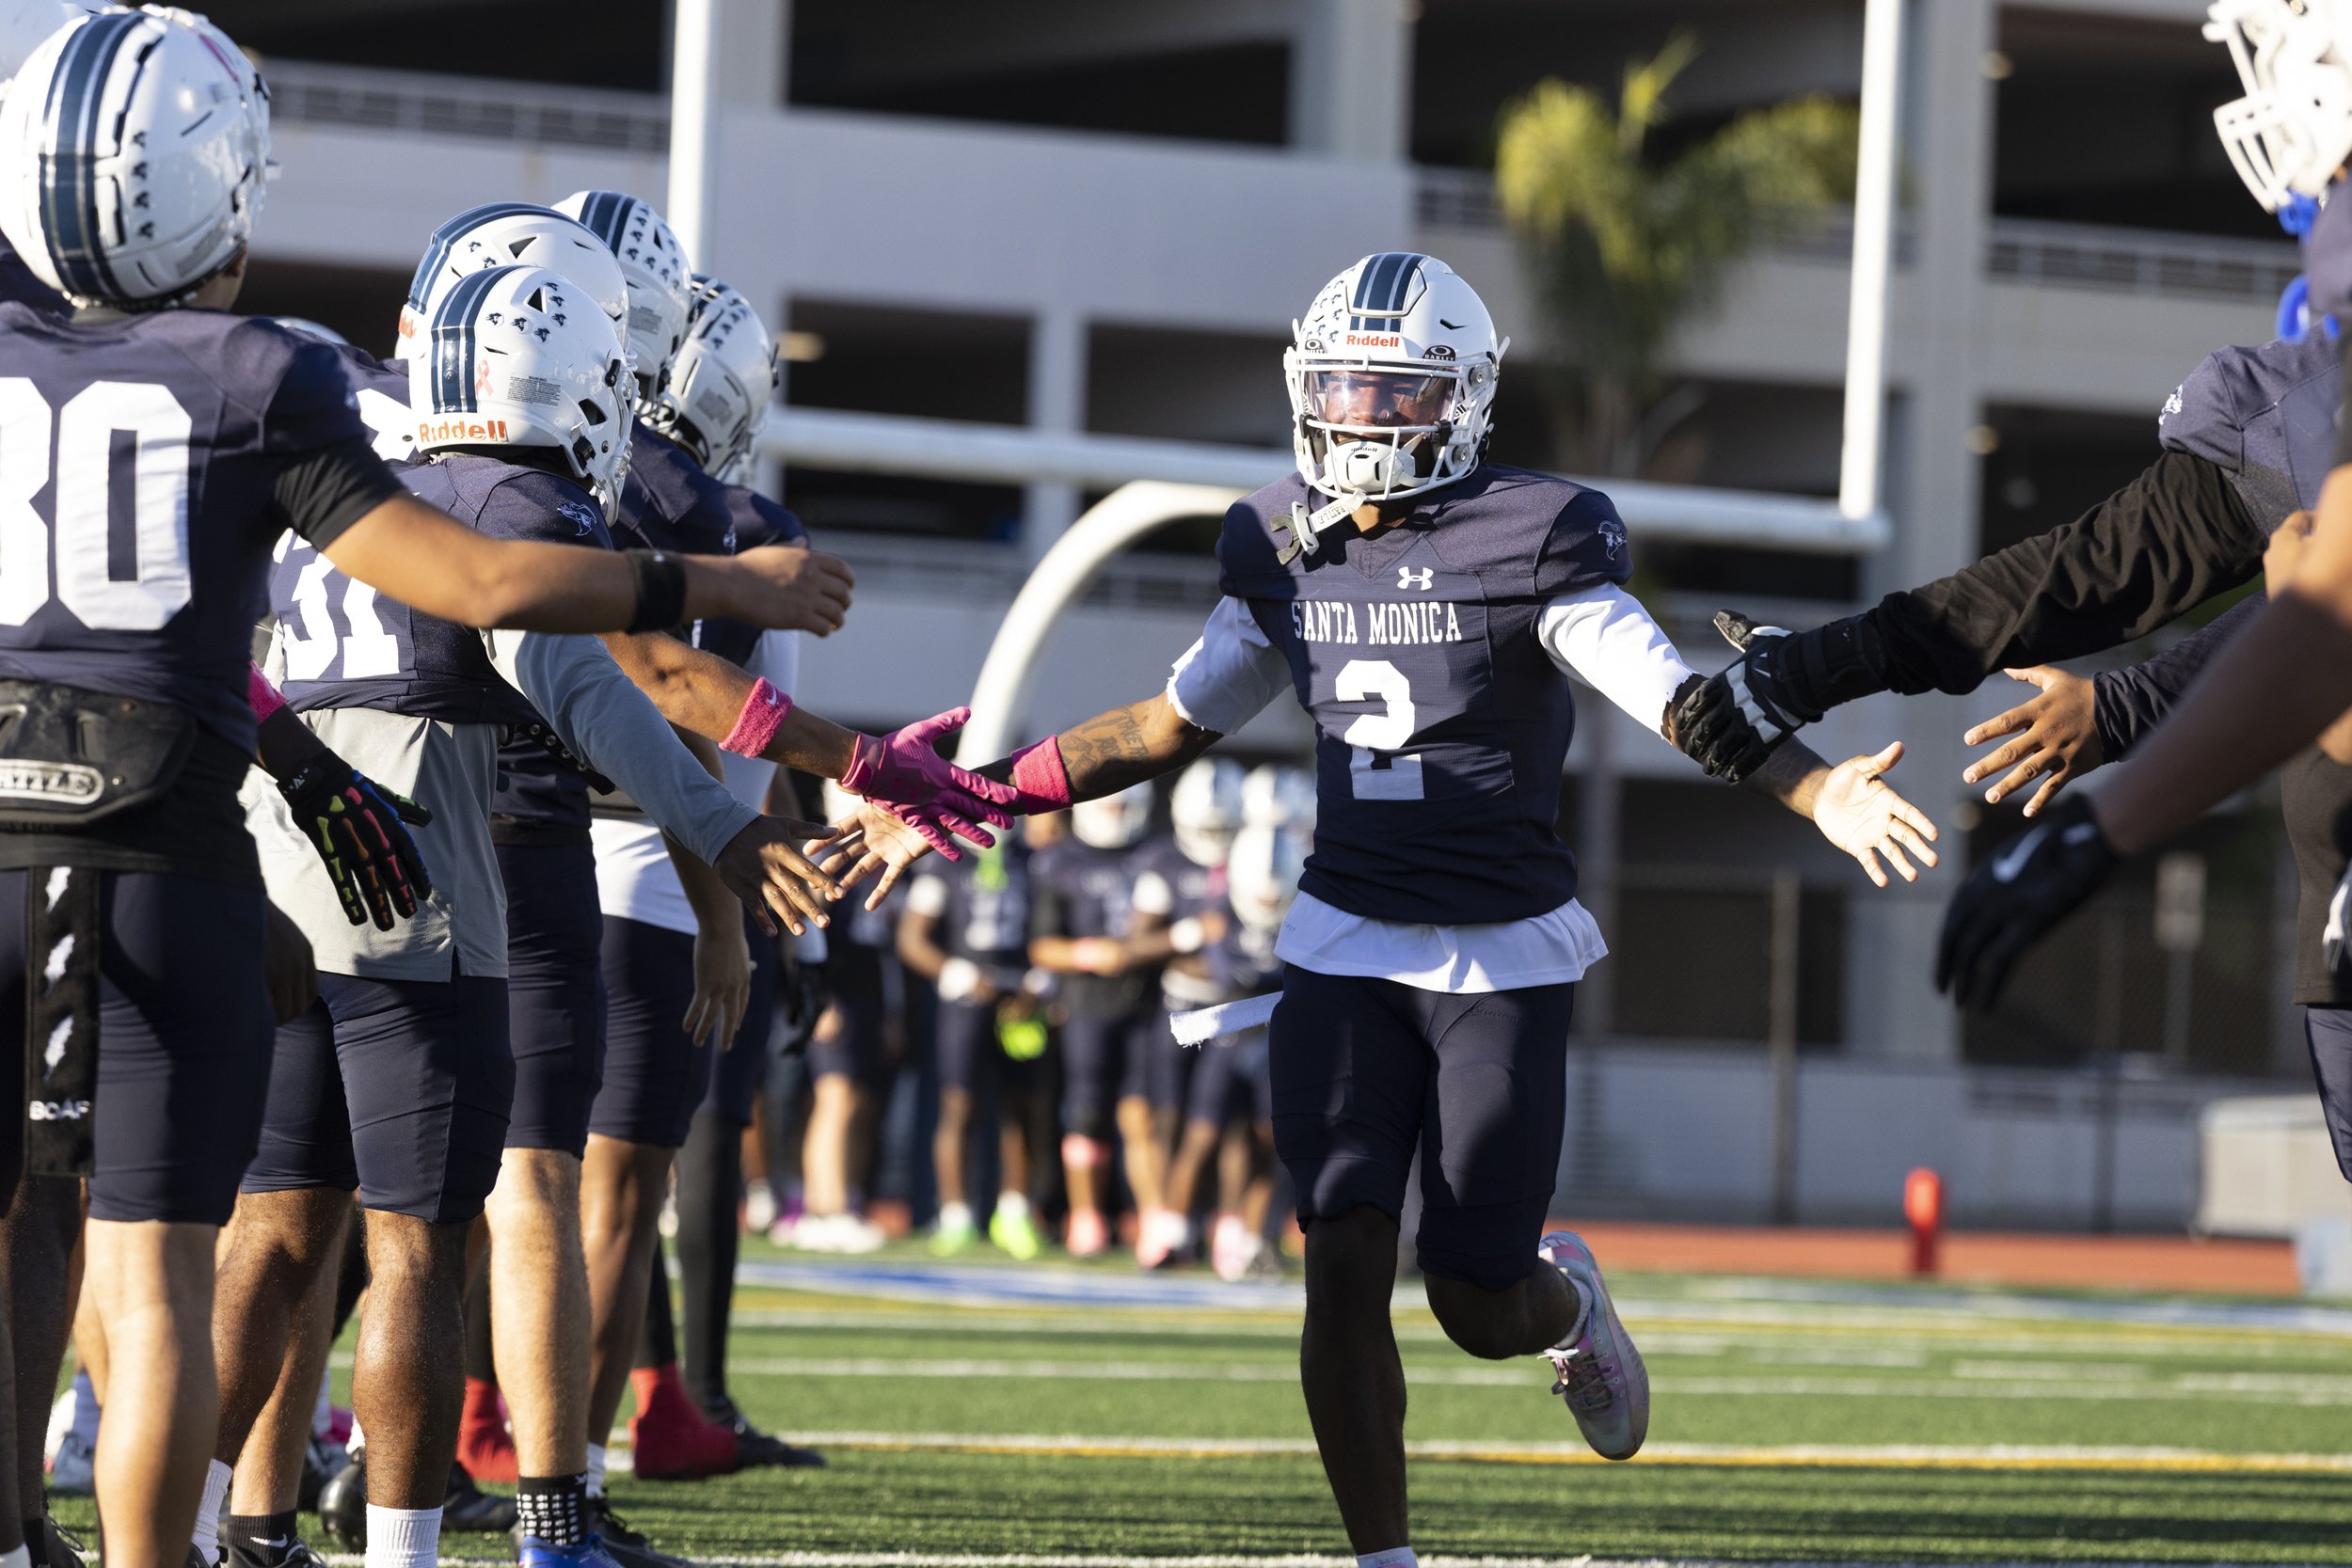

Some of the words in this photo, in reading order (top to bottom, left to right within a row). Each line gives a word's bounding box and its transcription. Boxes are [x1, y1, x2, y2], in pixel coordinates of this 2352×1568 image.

[1346, 334, 1399, 347] Riddell
[419, 420, 509, 443] Riddell
[1292, 600, 1358, 643] SANTA
[1368, 601, 1462, 644] MONICA
[1335, 659, 1424, 800] 2
